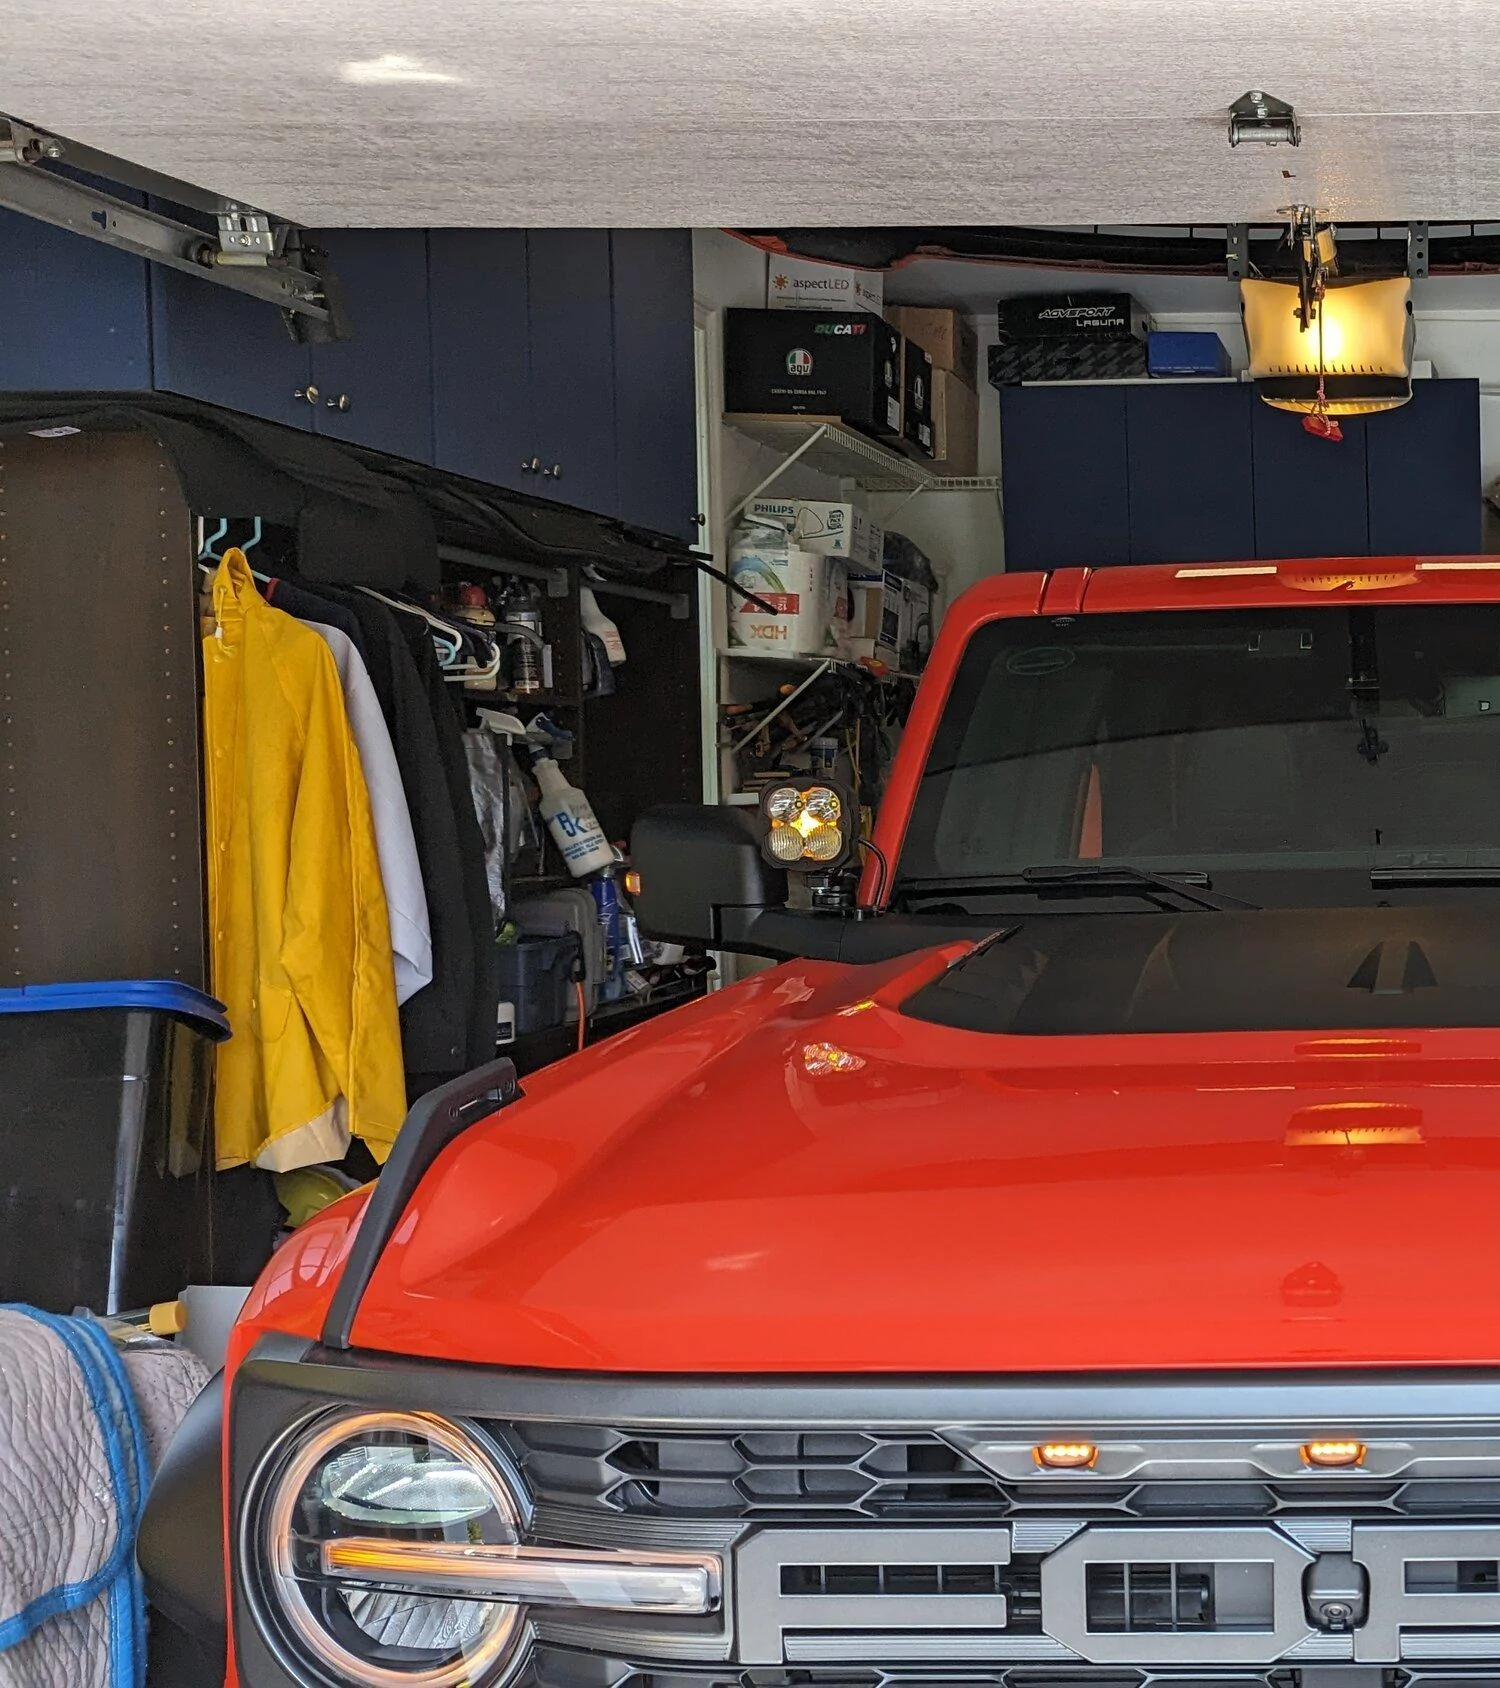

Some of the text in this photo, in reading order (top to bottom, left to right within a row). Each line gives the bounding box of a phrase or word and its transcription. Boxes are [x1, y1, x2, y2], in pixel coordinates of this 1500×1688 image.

[793, 277, 850, 290] aspectLED
[1076, 318, 1125, 327] LAGUNA
[814, 323, 868, 335] DUCATI
[790, 363, 811, 375] agv
[754, 503, 795, 515] PHILIPS
[750, 624, 788, 640] HDX
